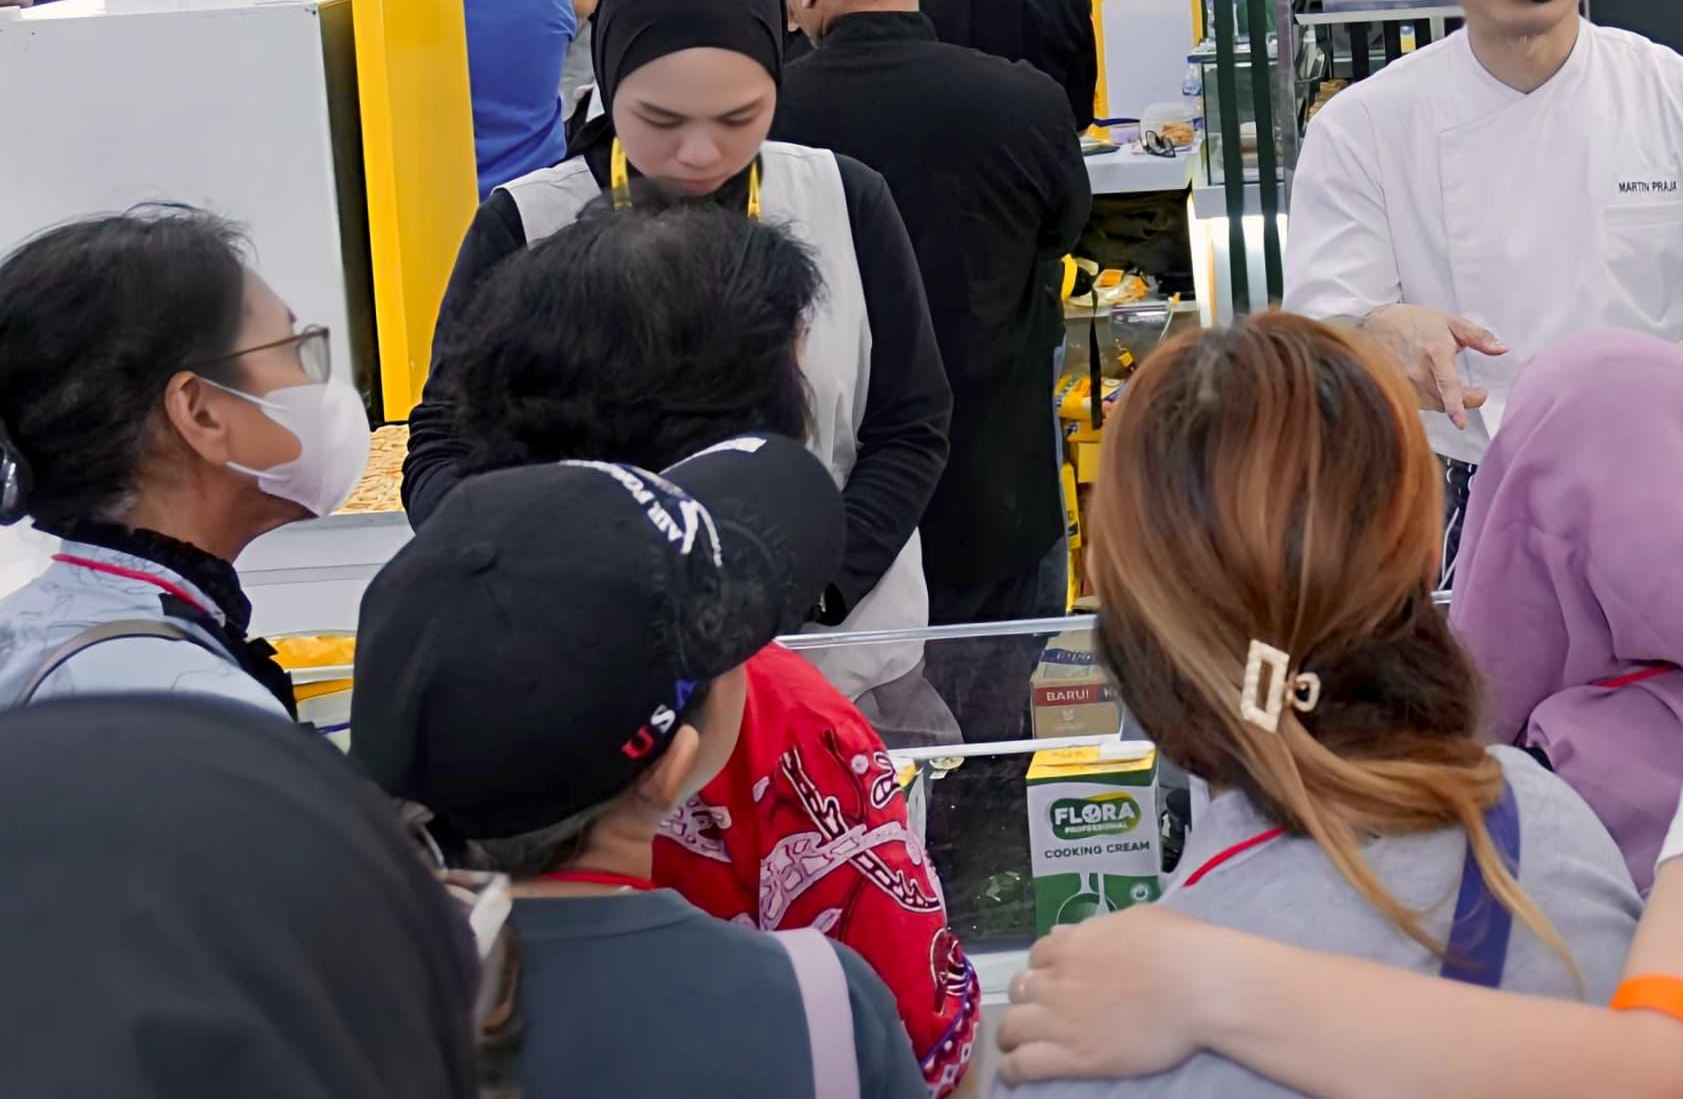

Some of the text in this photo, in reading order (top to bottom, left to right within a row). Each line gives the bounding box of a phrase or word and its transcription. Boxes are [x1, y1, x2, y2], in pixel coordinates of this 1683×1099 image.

[1618, 181, 1678, 193] MARTIN PRAJA
[1046, 689, 1089, 702] BARU!
[621, 677, 697, 758] USA
[1054, 802, 1136, 825] FLORA
[1044, 841, 1151, 859] COOKING CREAM
